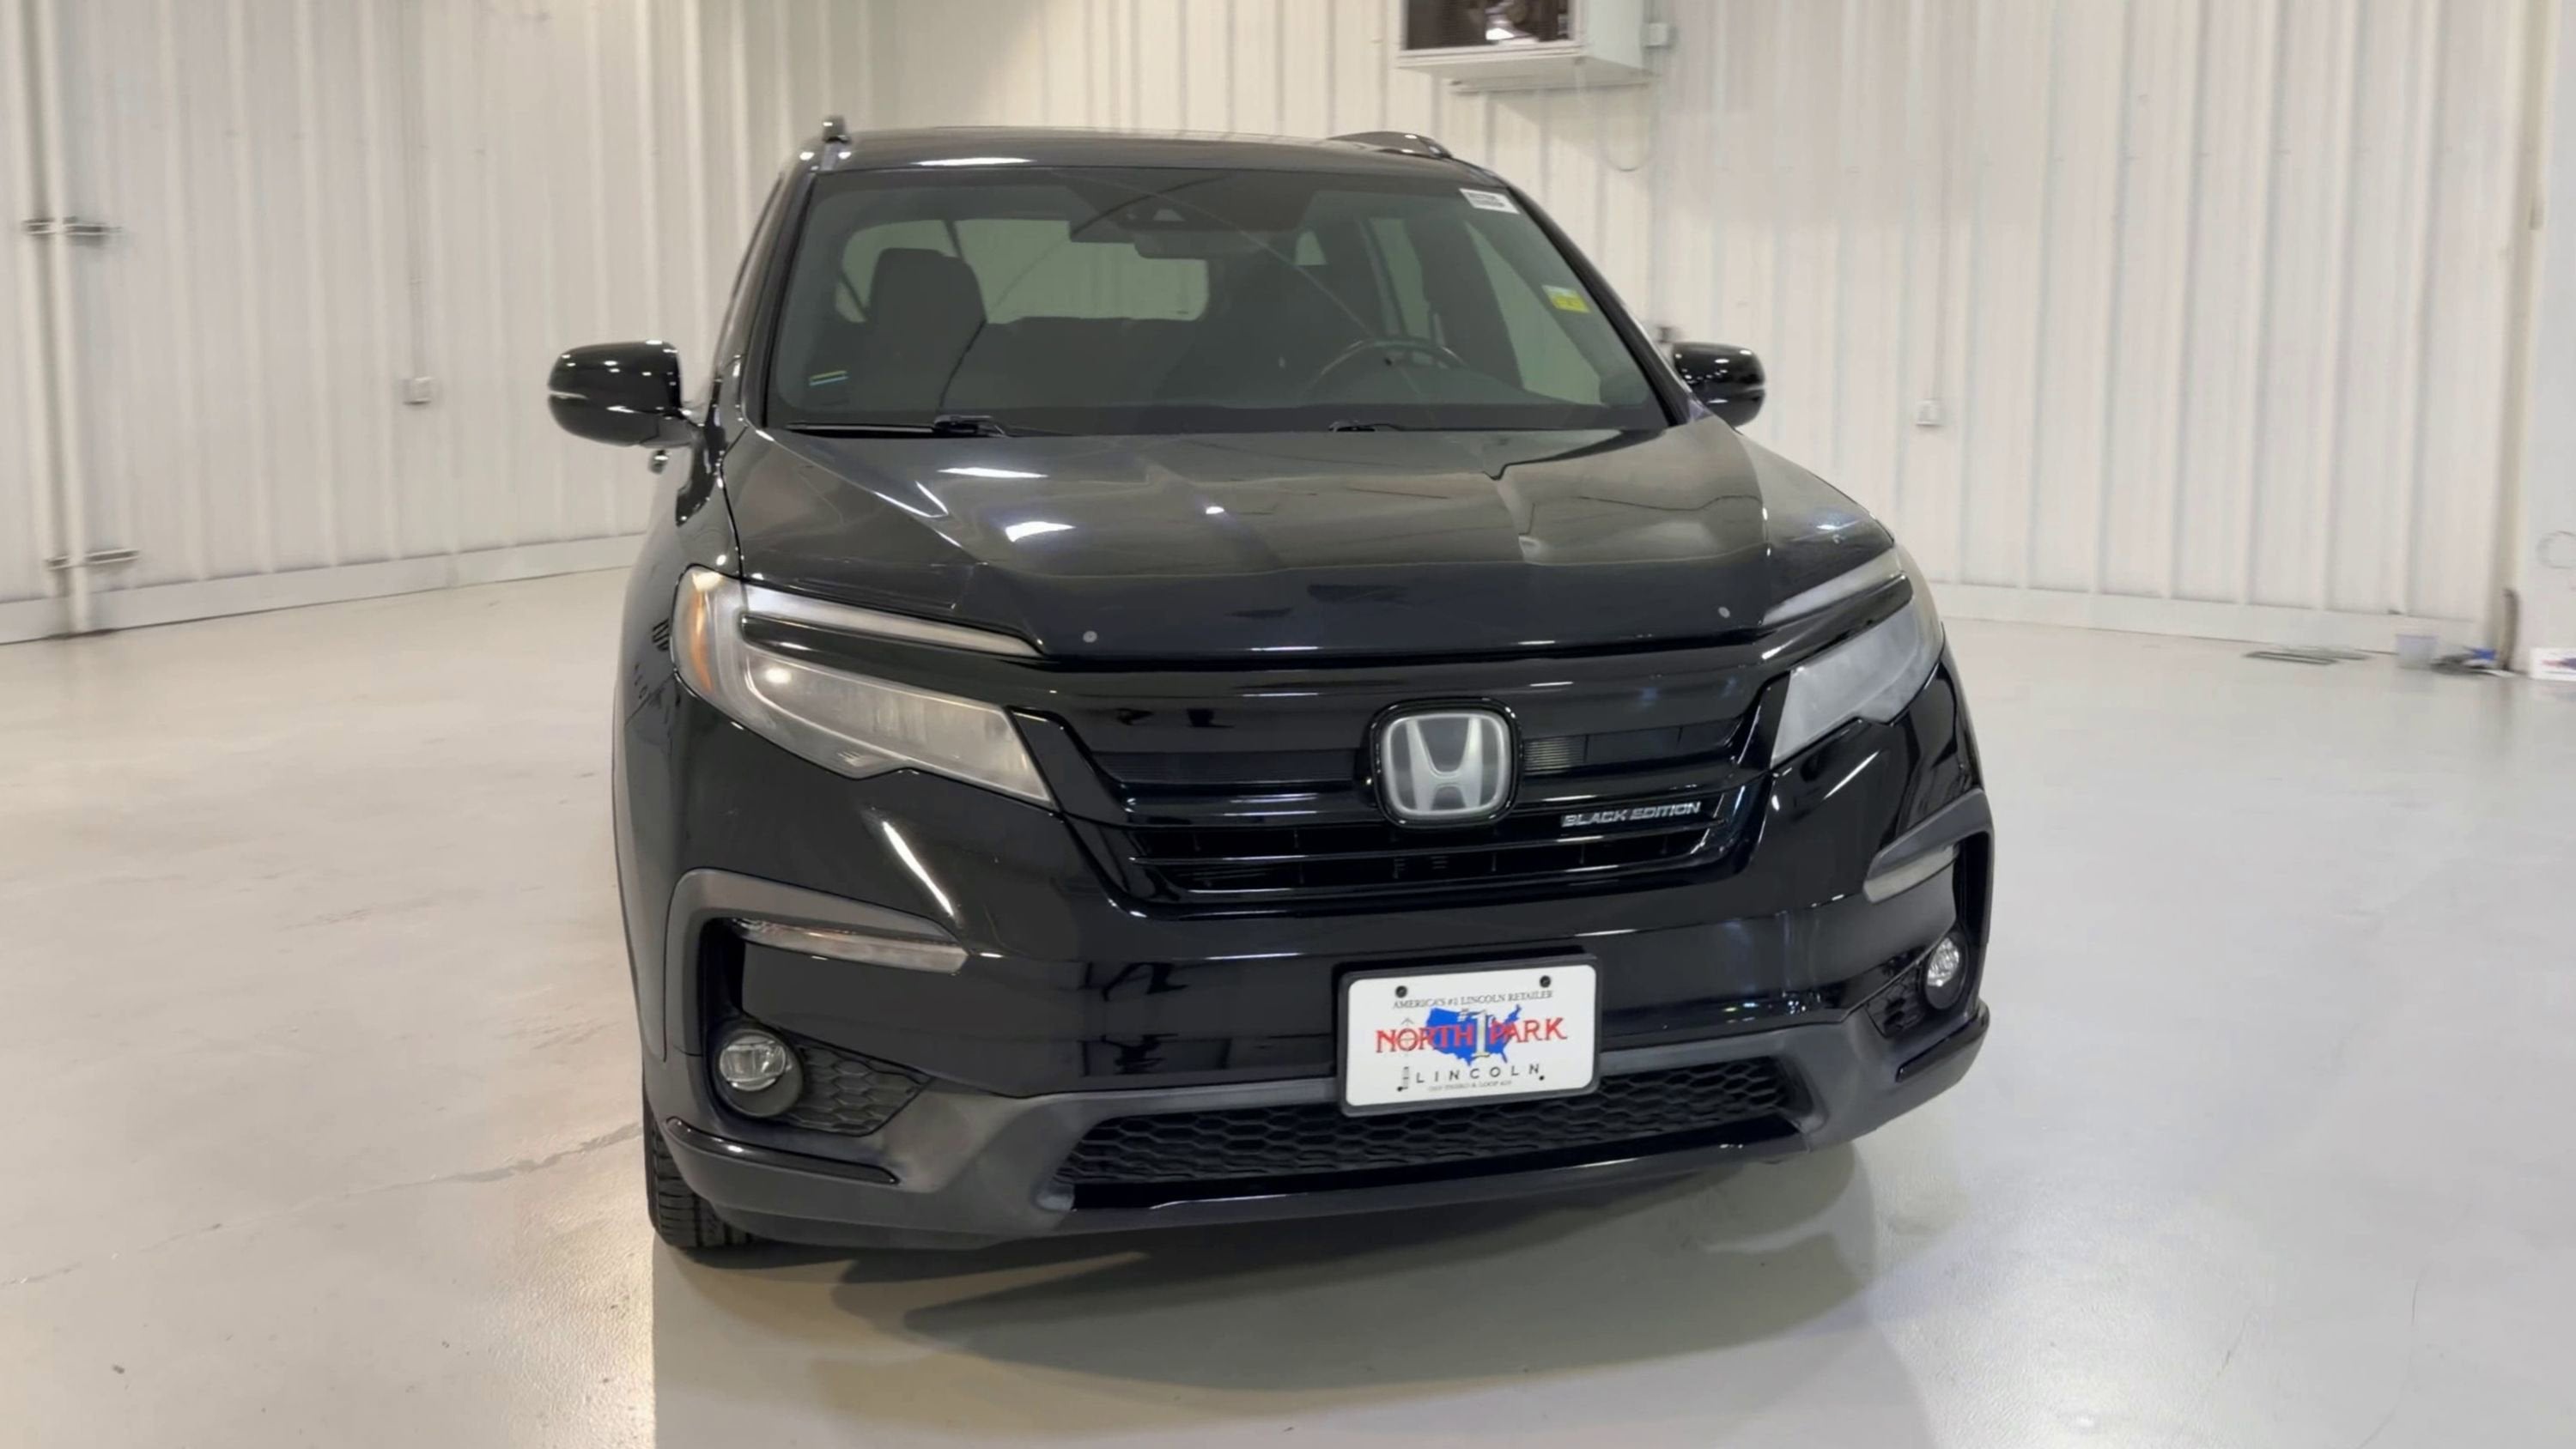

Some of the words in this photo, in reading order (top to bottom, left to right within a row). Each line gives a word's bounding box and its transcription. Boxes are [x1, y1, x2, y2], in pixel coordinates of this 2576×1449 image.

[1561, 809, 1628, 827] BLACK
[1630, 801, 1702, 821] EDITION
[1393, 996, 1446, 1009] AMERICA'S
[1461, 992, 1506, 1005] LINCOLN
[1508, 990, 1552, 1001] RETAILER
[1376, 1023, 1473, 1053] NORTH
[1489, 1017, 1568, 1045] PARK
[1416, 1064, 1540, 1083] LINCOLN
